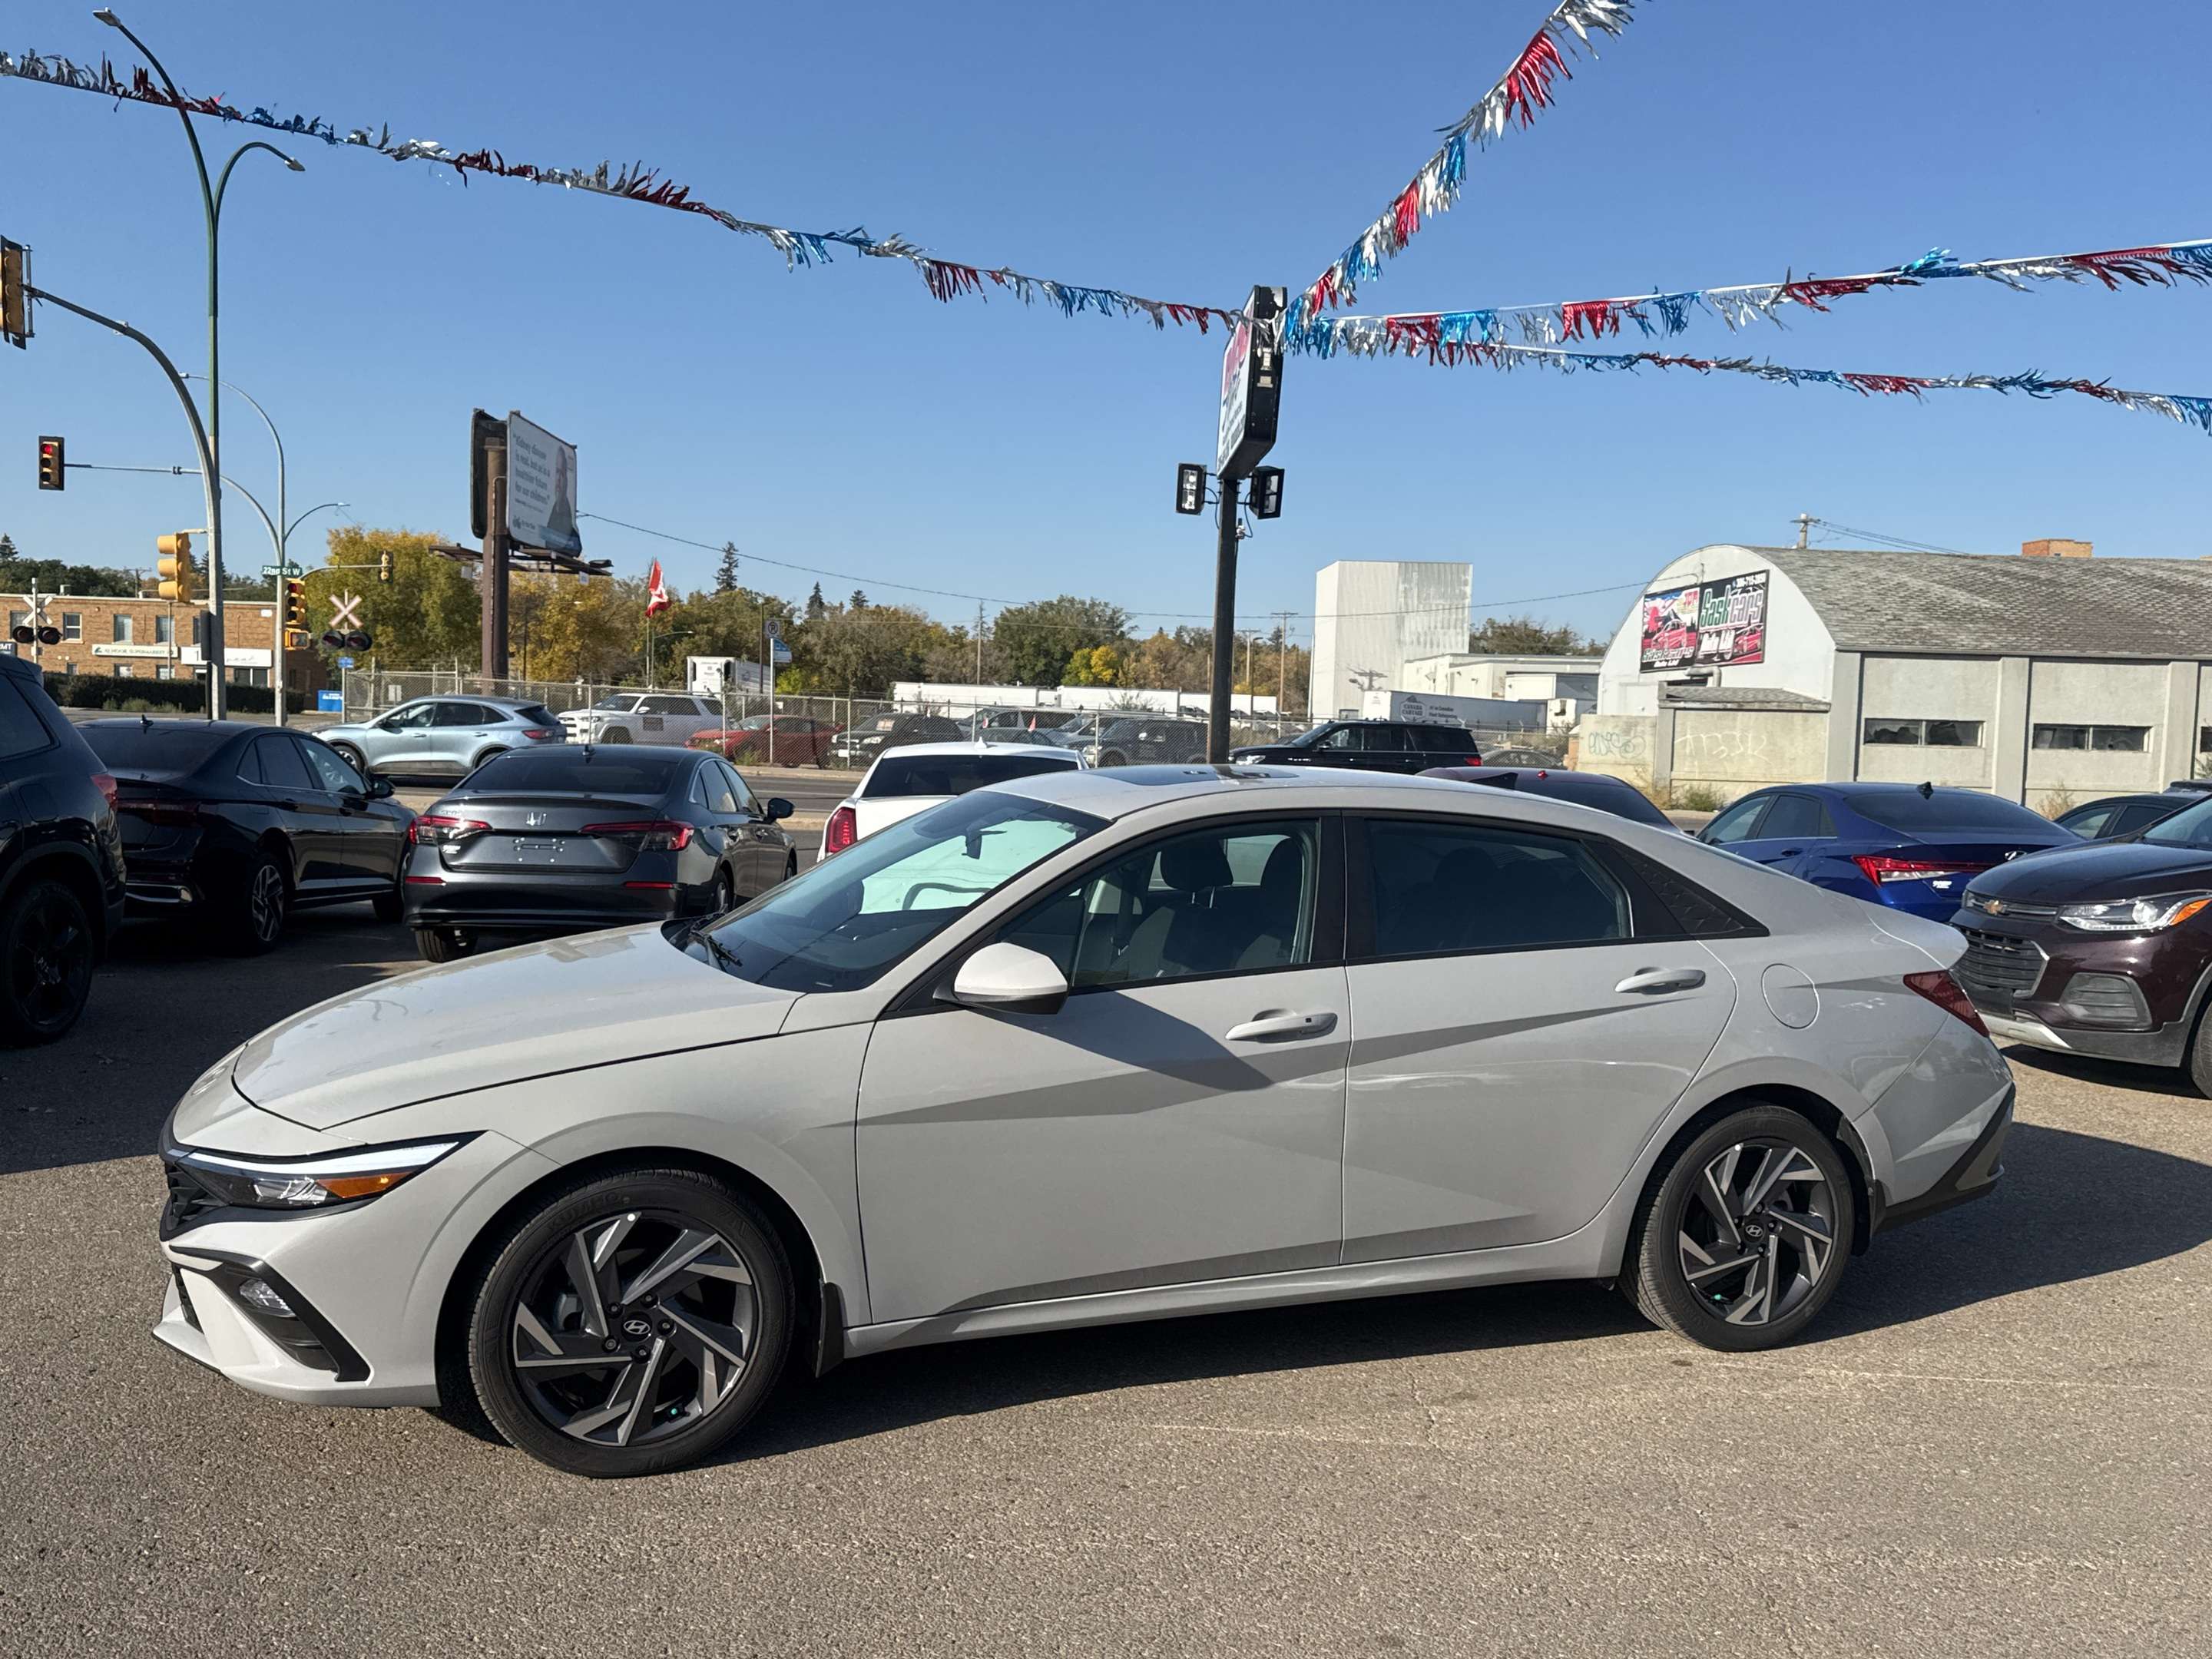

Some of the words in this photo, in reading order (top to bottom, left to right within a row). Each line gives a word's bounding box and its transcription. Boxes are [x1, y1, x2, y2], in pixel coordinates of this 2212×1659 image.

[263, 567, 280, 575] 22nd
[282, 567, 291, 575] St
[292, 568, 300, 576] W
